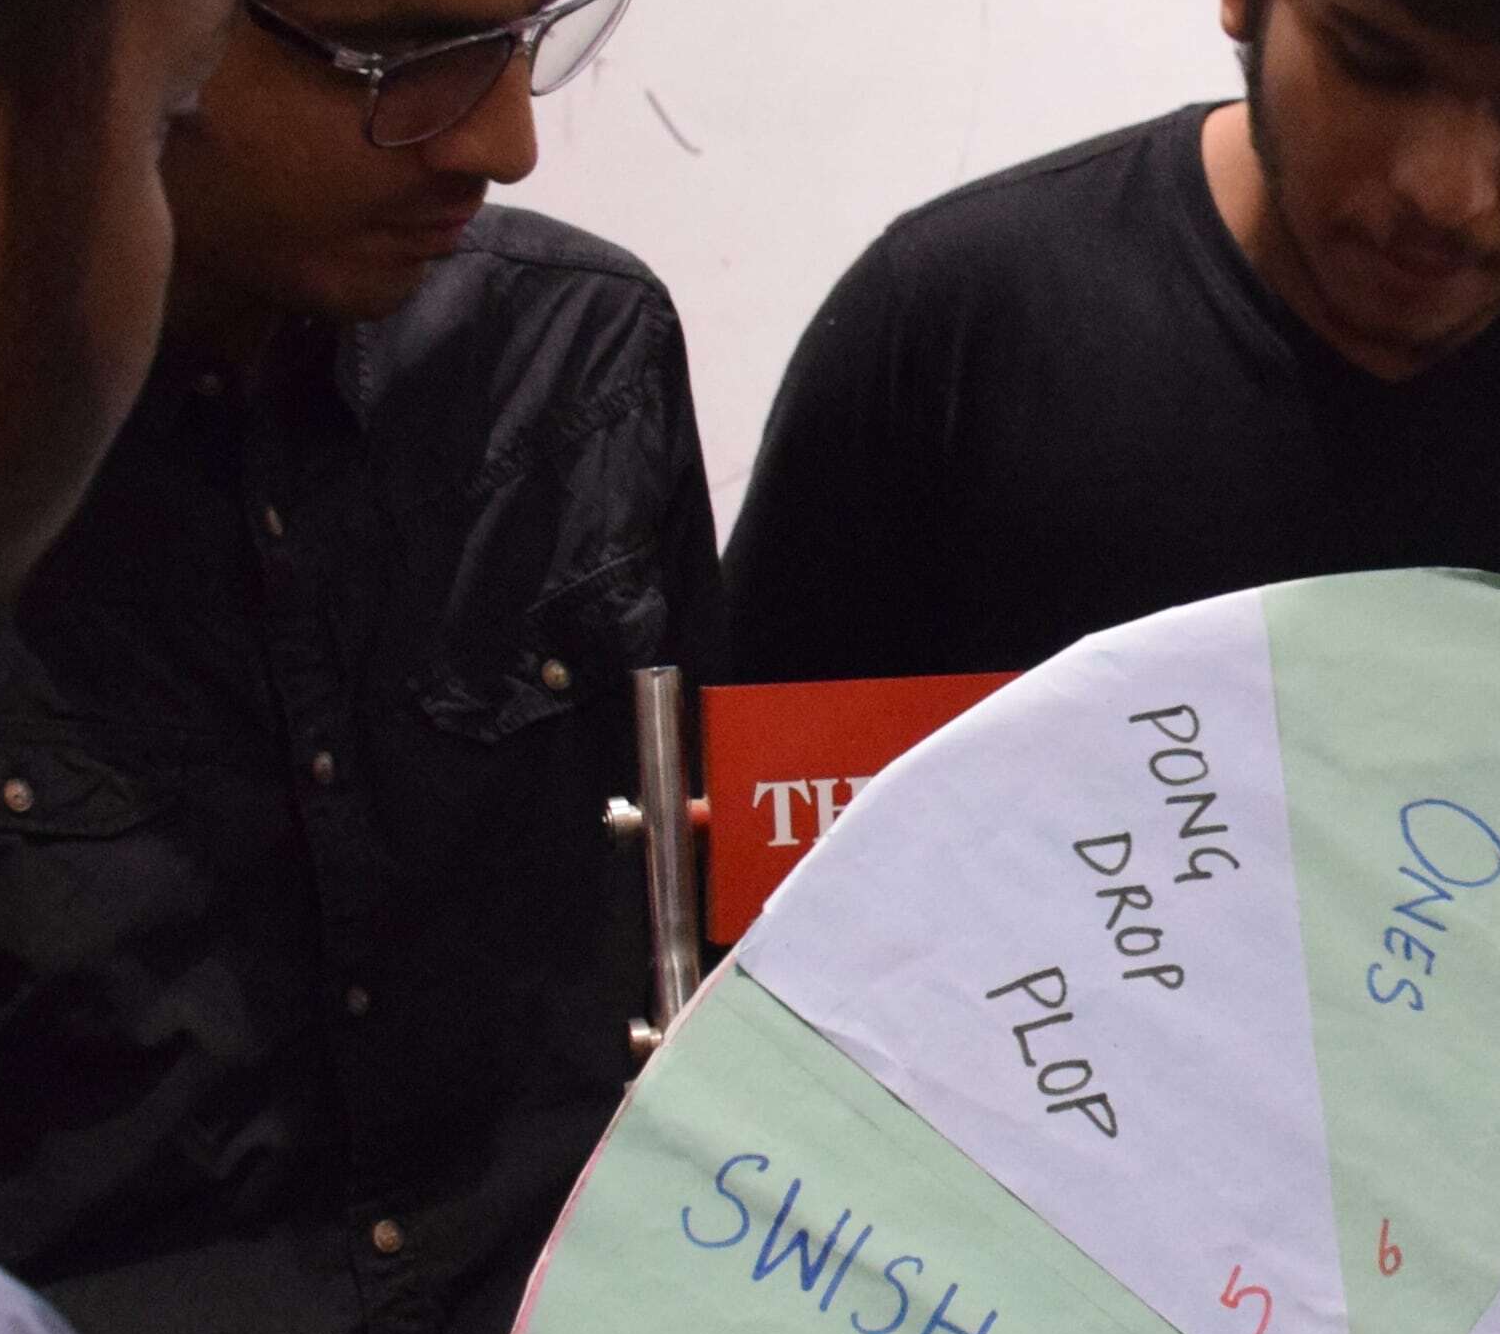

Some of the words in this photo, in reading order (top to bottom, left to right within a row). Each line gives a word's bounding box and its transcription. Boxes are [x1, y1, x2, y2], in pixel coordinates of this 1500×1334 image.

[1128, 704, 1240, 883] PONG
[1072, 831, 1184, 990] DROP
[985, 966, 1118, 1139] PLOP
[1379, 1219, 1402, 1275] 6
